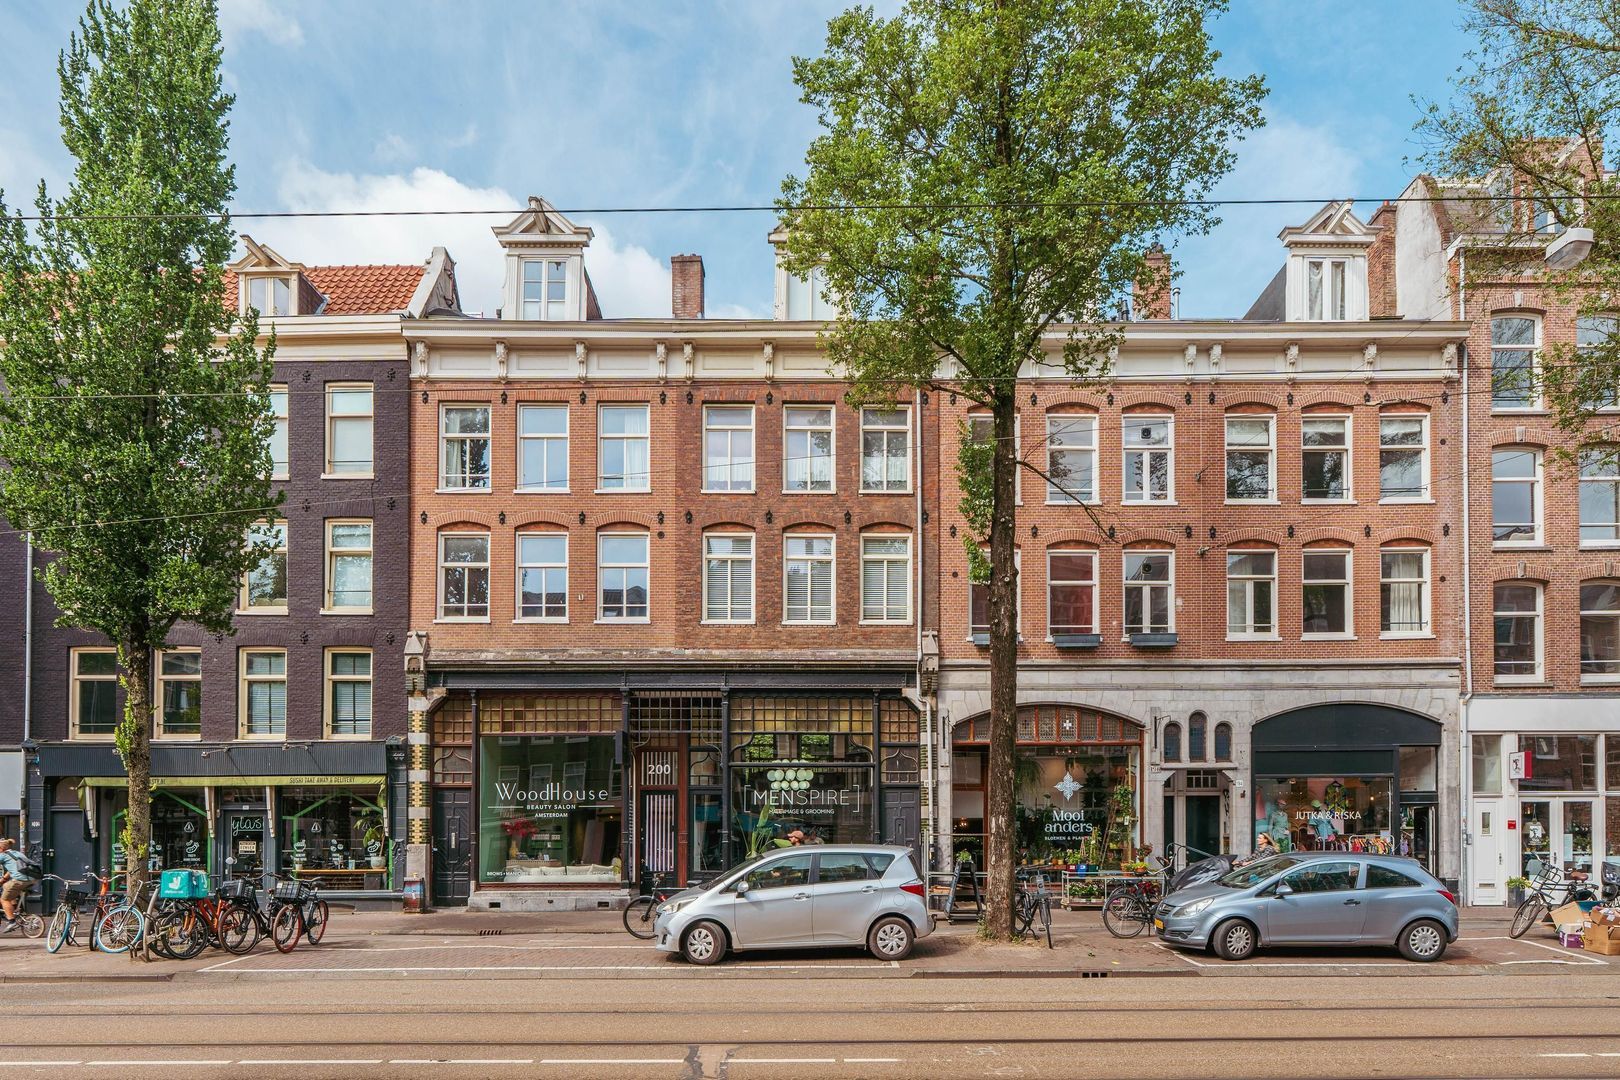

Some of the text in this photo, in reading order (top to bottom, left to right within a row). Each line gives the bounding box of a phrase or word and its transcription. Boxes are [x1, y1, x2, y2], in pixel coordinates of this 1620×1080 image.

[648, 764, 671, 775] 200
[495, 782, 609, 801] WoodHouse
[753, 789, 850, 805] MENSPIRE
[1052, 810, 1085, 821] Mooi
[1295, 811, 1362, 820] JUTKA & RISKA
[1044, 821, 1093, 833] anders
